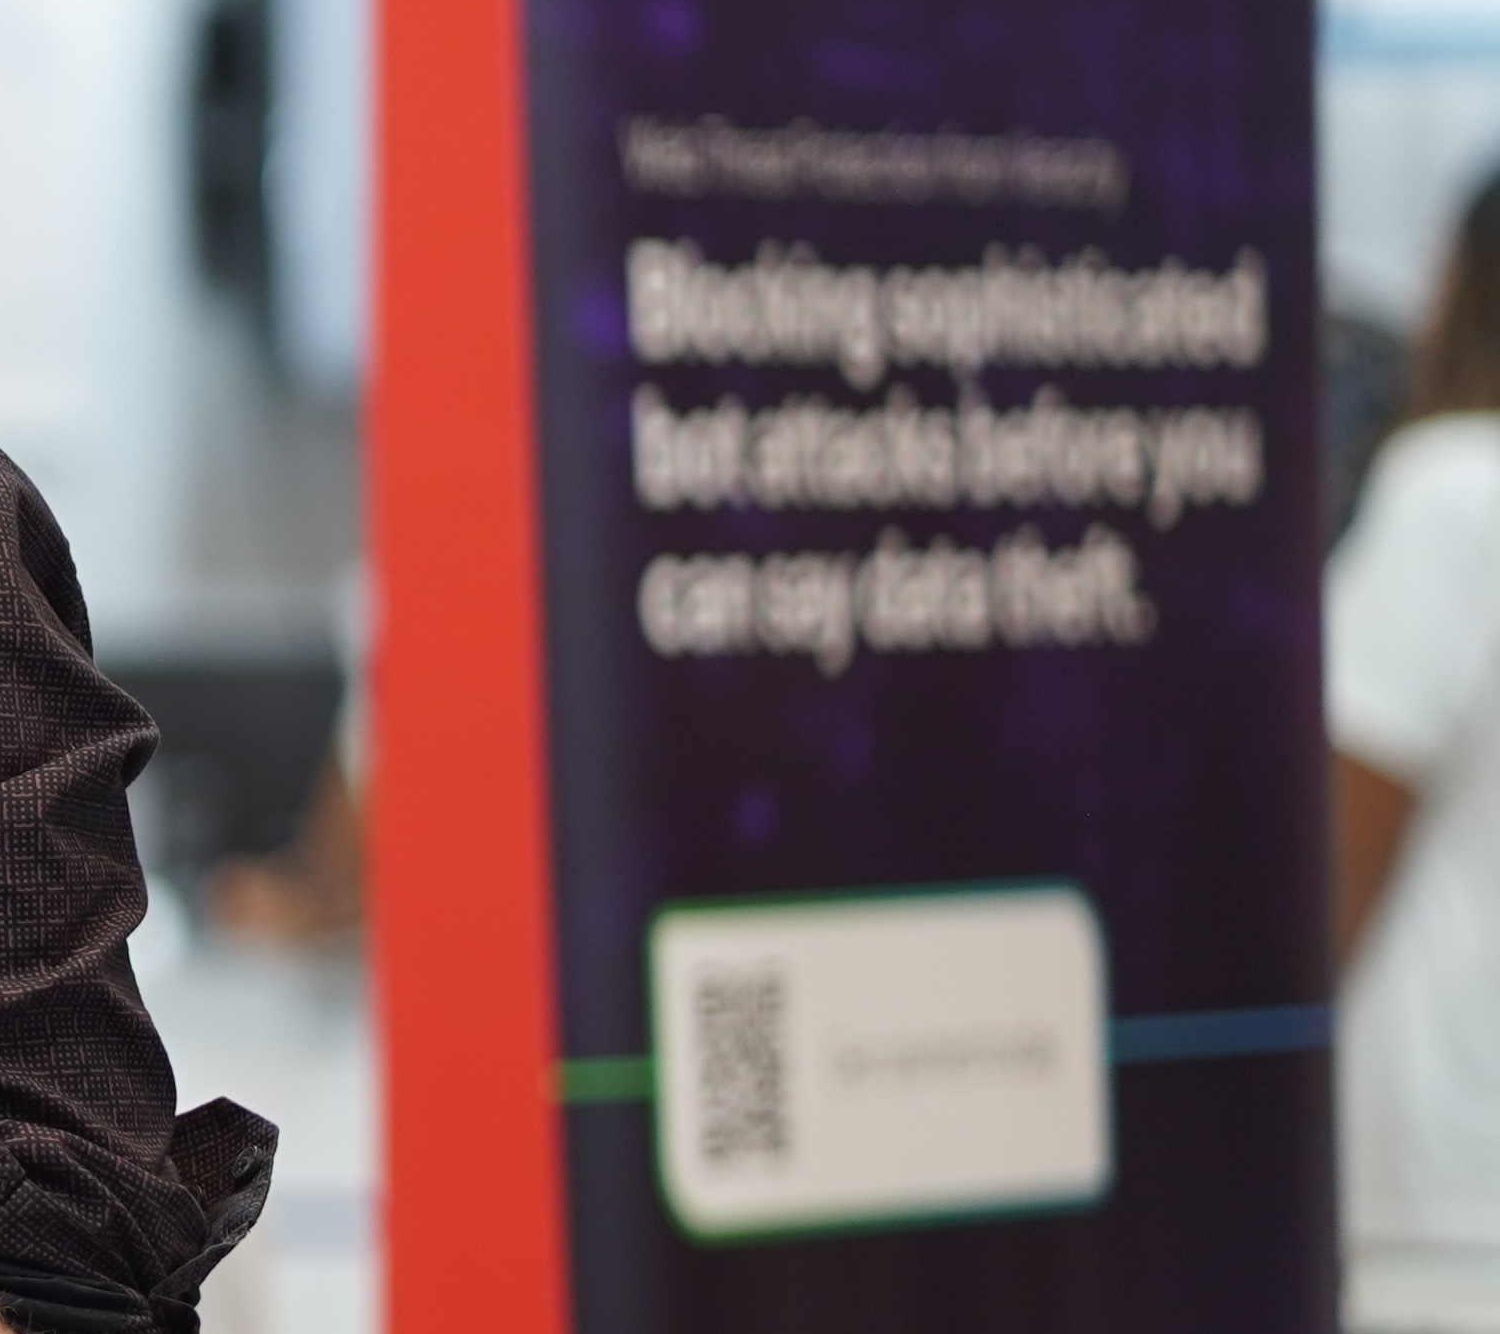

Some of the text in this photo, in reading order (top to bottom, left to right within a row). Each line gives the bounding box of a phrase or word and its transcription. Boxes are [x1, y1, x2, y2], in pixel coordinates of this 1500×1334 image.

[628, 240, 1266, 387] Blocking sophisticated
[957, 384, 1146, 507] before
[1147, 407, 1262, 529] you
[639, 554, 754, 655] can
[858, 527, 992, 651] data
